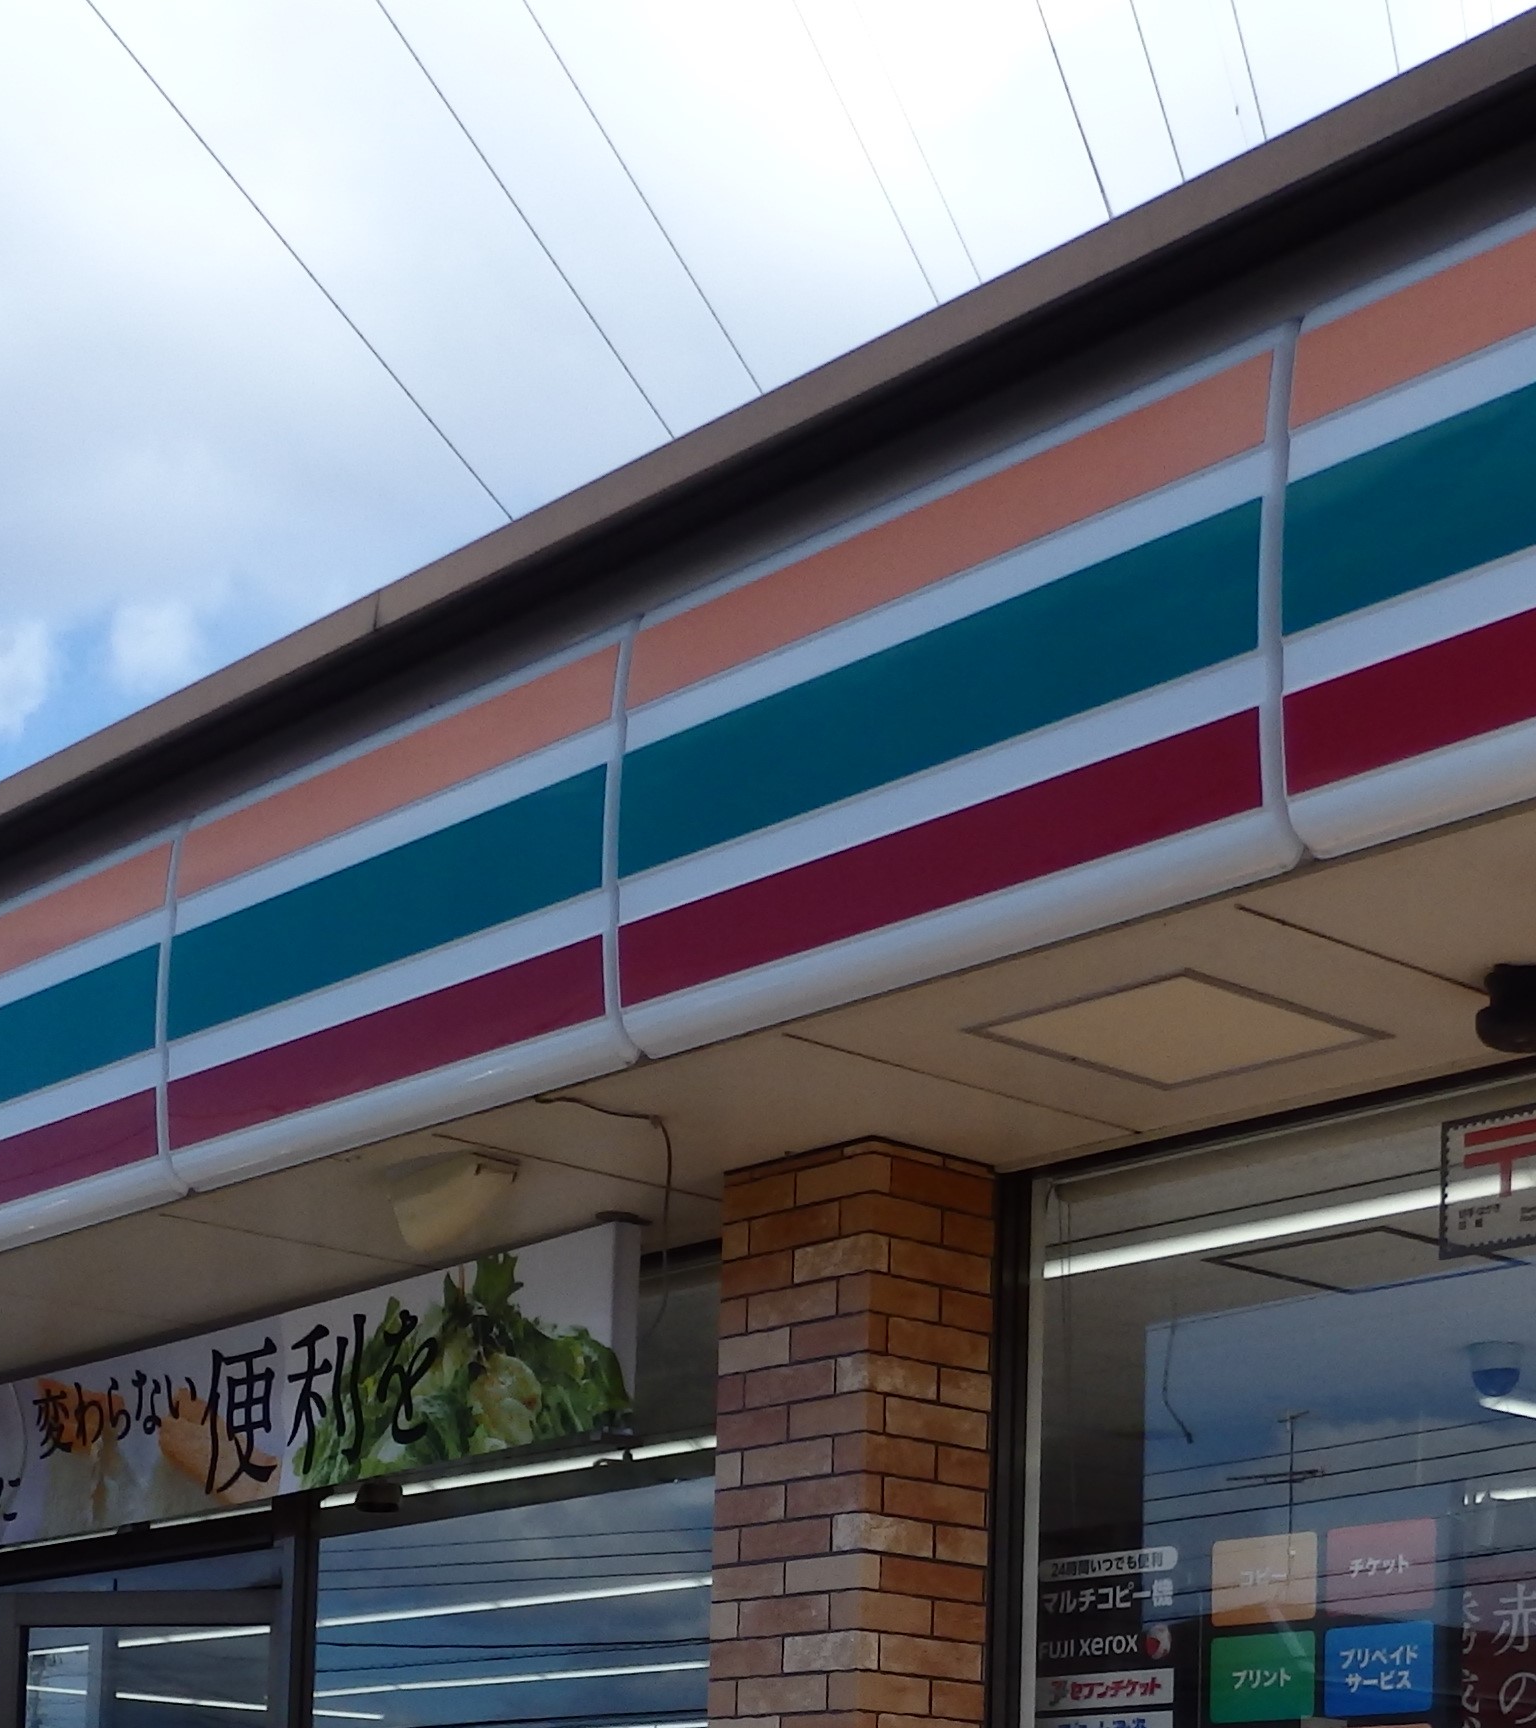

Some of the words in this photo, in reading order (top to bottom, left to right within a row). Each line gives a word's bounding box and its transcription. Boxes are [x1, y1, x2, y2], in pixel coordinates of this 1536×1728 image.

[33, 1309, 440, 1495] 変わらない便利を
[1240, 1568, 1287, 1587] コピー
[1349, 1554, 1410, 1579] チケット
[1041, 1578, 1174, 1615] マルチコピー機
[1339, 1644, 1418, 1670] プリペイド
[1232, 1667, 1292, 1690] プリント
[1344, 1670, 1412, 1694] サービス
